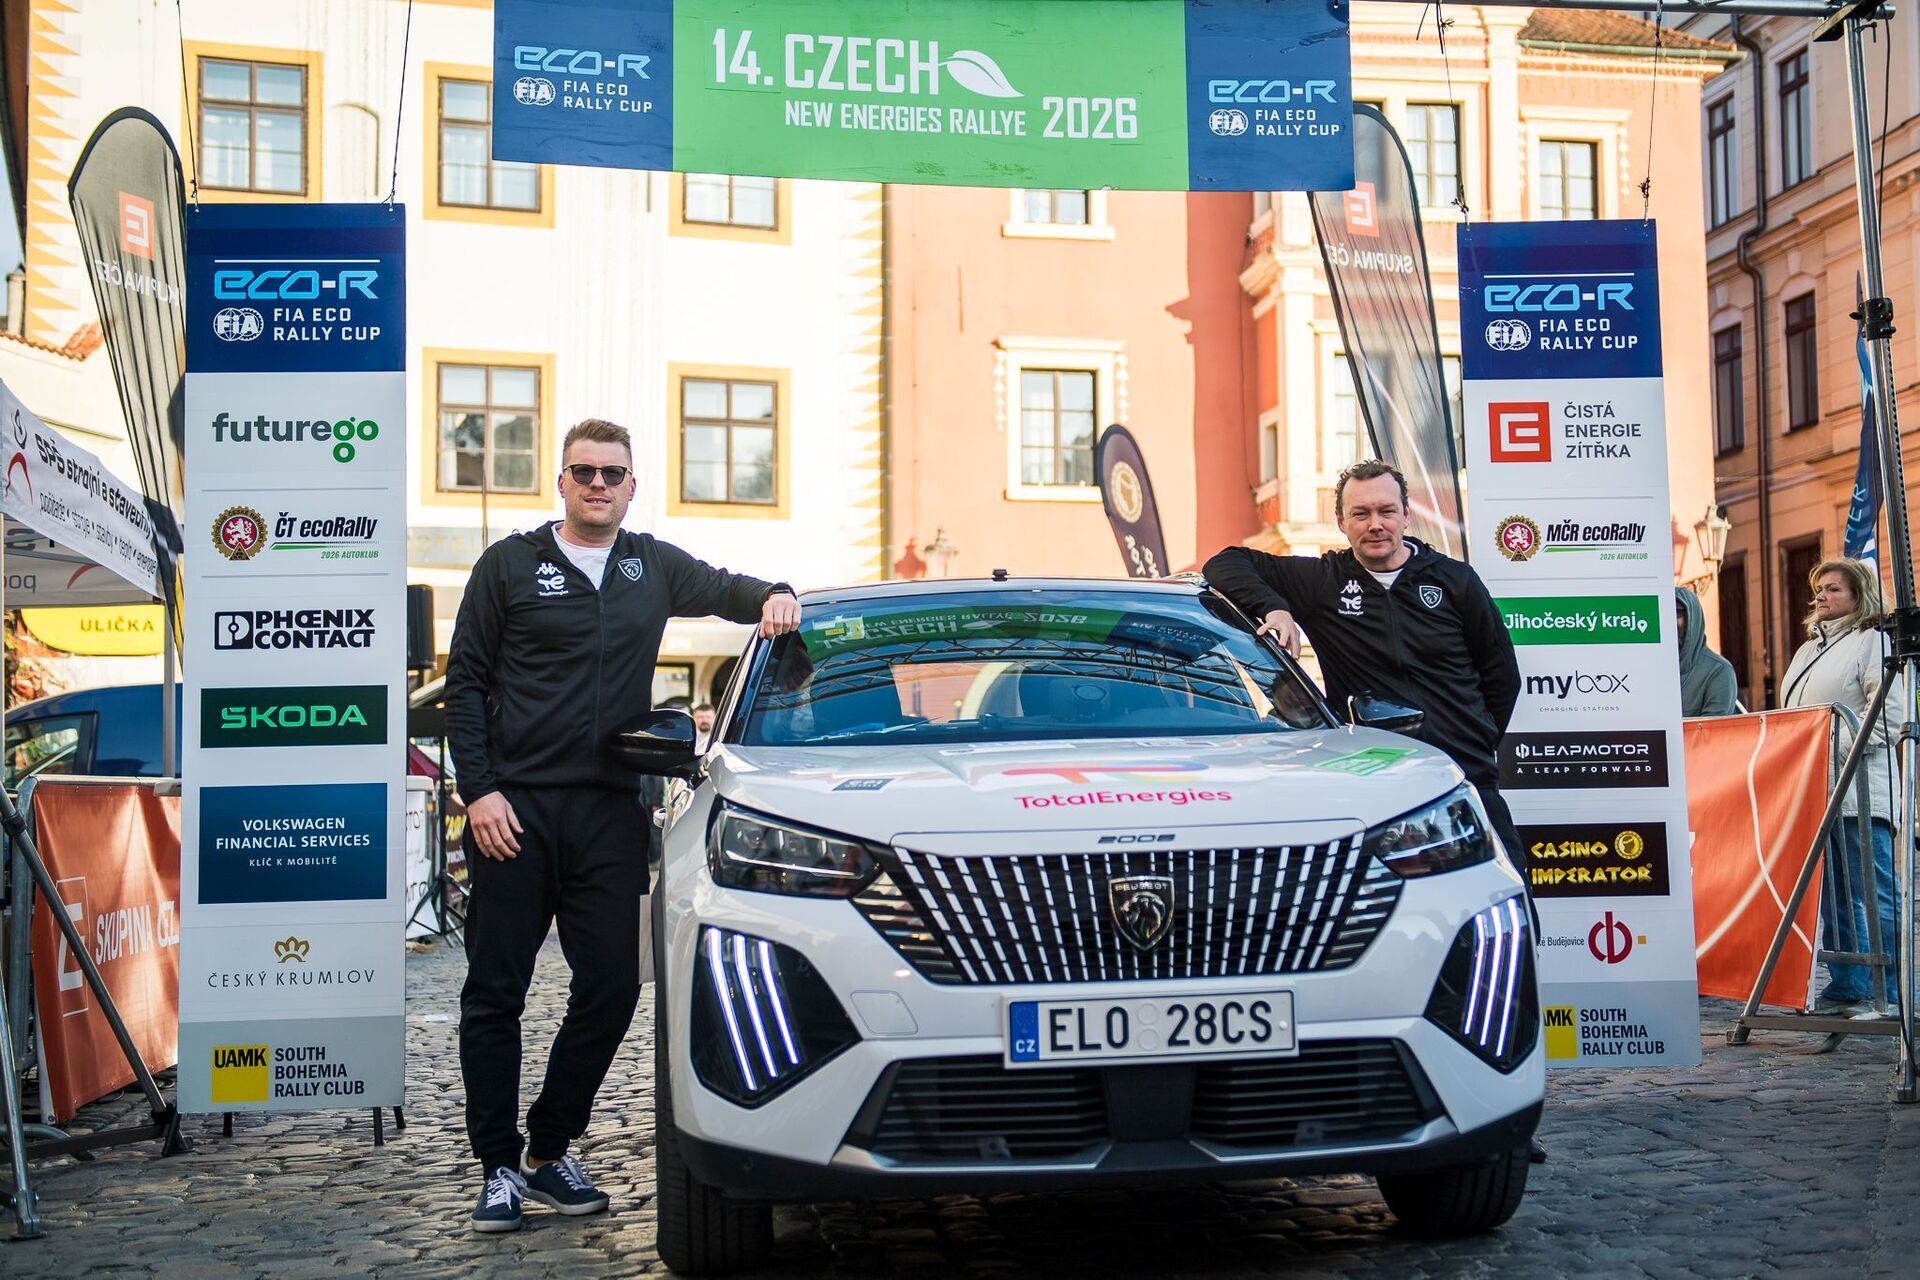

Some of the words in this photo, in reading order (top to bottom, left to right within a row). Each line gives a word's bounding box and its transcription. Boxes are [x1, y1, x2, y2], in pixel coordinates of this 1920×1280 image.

[712, 28, 774, 86] 14.
[785, 34, 939, 95] CZECH
[564, 80, 590, 94] FIA
[596, 83, 628, 96] ECO
[563, 96, 613, 110] RALLY
[619, 99, 653, 113] CUP
[785, 100, 833, 129] NEW
[840, 103, 942, 133] ENERGIES
[949, 108, 1026, 136] RALLYE
[1042, 96, 1138, 140] 2026
[1255, 109, 1280, 121] FIA
[1286, 109, 1316, 121] ECO
[1255, 124, 1302, 136] RALLY
[1309, 124, 1340, 136] CUP
[273, 308, 305, 322] FIA
[312, 308, 352, 322] ECO
[1539, 319, 1568, 332] FIA
[1575, 318, 1611, 332] ECO
[273, 326, 333, 341] RALLY
[341, 326, 381, 341] CUP
[1540, 336, 1595, 350] RALLY
[1602, 335, 1638, 349] CUP
[1564, 401, 1615, 418] ČISTÁ
[1565, 423, 1642, 438] ENERGIE
[1566, 441, 1631, 459] ZÍTŘKA
[274, 512, 297, 538] ČT
[299, 516, 378, 540] ecoRally
[1546, 519, 1580, 542] MČR
[1582, 523, 1646, 543] ecoRally
[321, 551, 340, 559] 2026
[341, 550, 379, 559] AUTOKLUB
[1616, 552, 1648, 560] AUTOKLUB
[80, 617, 154, 632] ULIČKA
[1504, 611, 1597, 631] Jihočeský
[1602, 611, 1636, 631] kraj
[254, 629, 376, 650] CONTACT
[1532, 744, 1649, 757] LEAPMOTOR
[1581, 765, 1652, 774] FORWARD
[1014, 787, 1232, 810] TotalEnergies
[243, 818, 345, 832] VOLKSWAGEN
[216, 837, 296, 850] FINANCIAL
[301, 834, 370, 847] SERVICES
[1530, 841, 1609, 859] CASINO
[249, 857, 272, 867] KLÍČ
[276, 858, 283, 866] K
[287, 855, 337, 866] MOBILITĚ
[96, 904, 154, 966] SKUPINA
[1547, 935, 1585, 949] Budějovice
[208, 970, 267, 987] ČESKÝ
[276, 969, 375, 986] KRUMLOV
[1580, 1008, 1627, 1022] SOUTH
[1015, 1039, 1036, 1053] CZ
[1167, 1000, 1272, 1047] 28CS
[1581, 1025, 1648, 1039] BOHEMIA
[275, 1046, 326, 1062] SOUTH
[1582, 1041, 1624, 1056] RALLY
[1627, 1040, 1665, 1054] CLUB
[214, 1048, 266, 1069] UAMK
[275, 1063, 348, 1080] BOHEMIA
[275, 1082, 320, 1097] RALLY
[324, 1080, 364, 1096] CLUB
